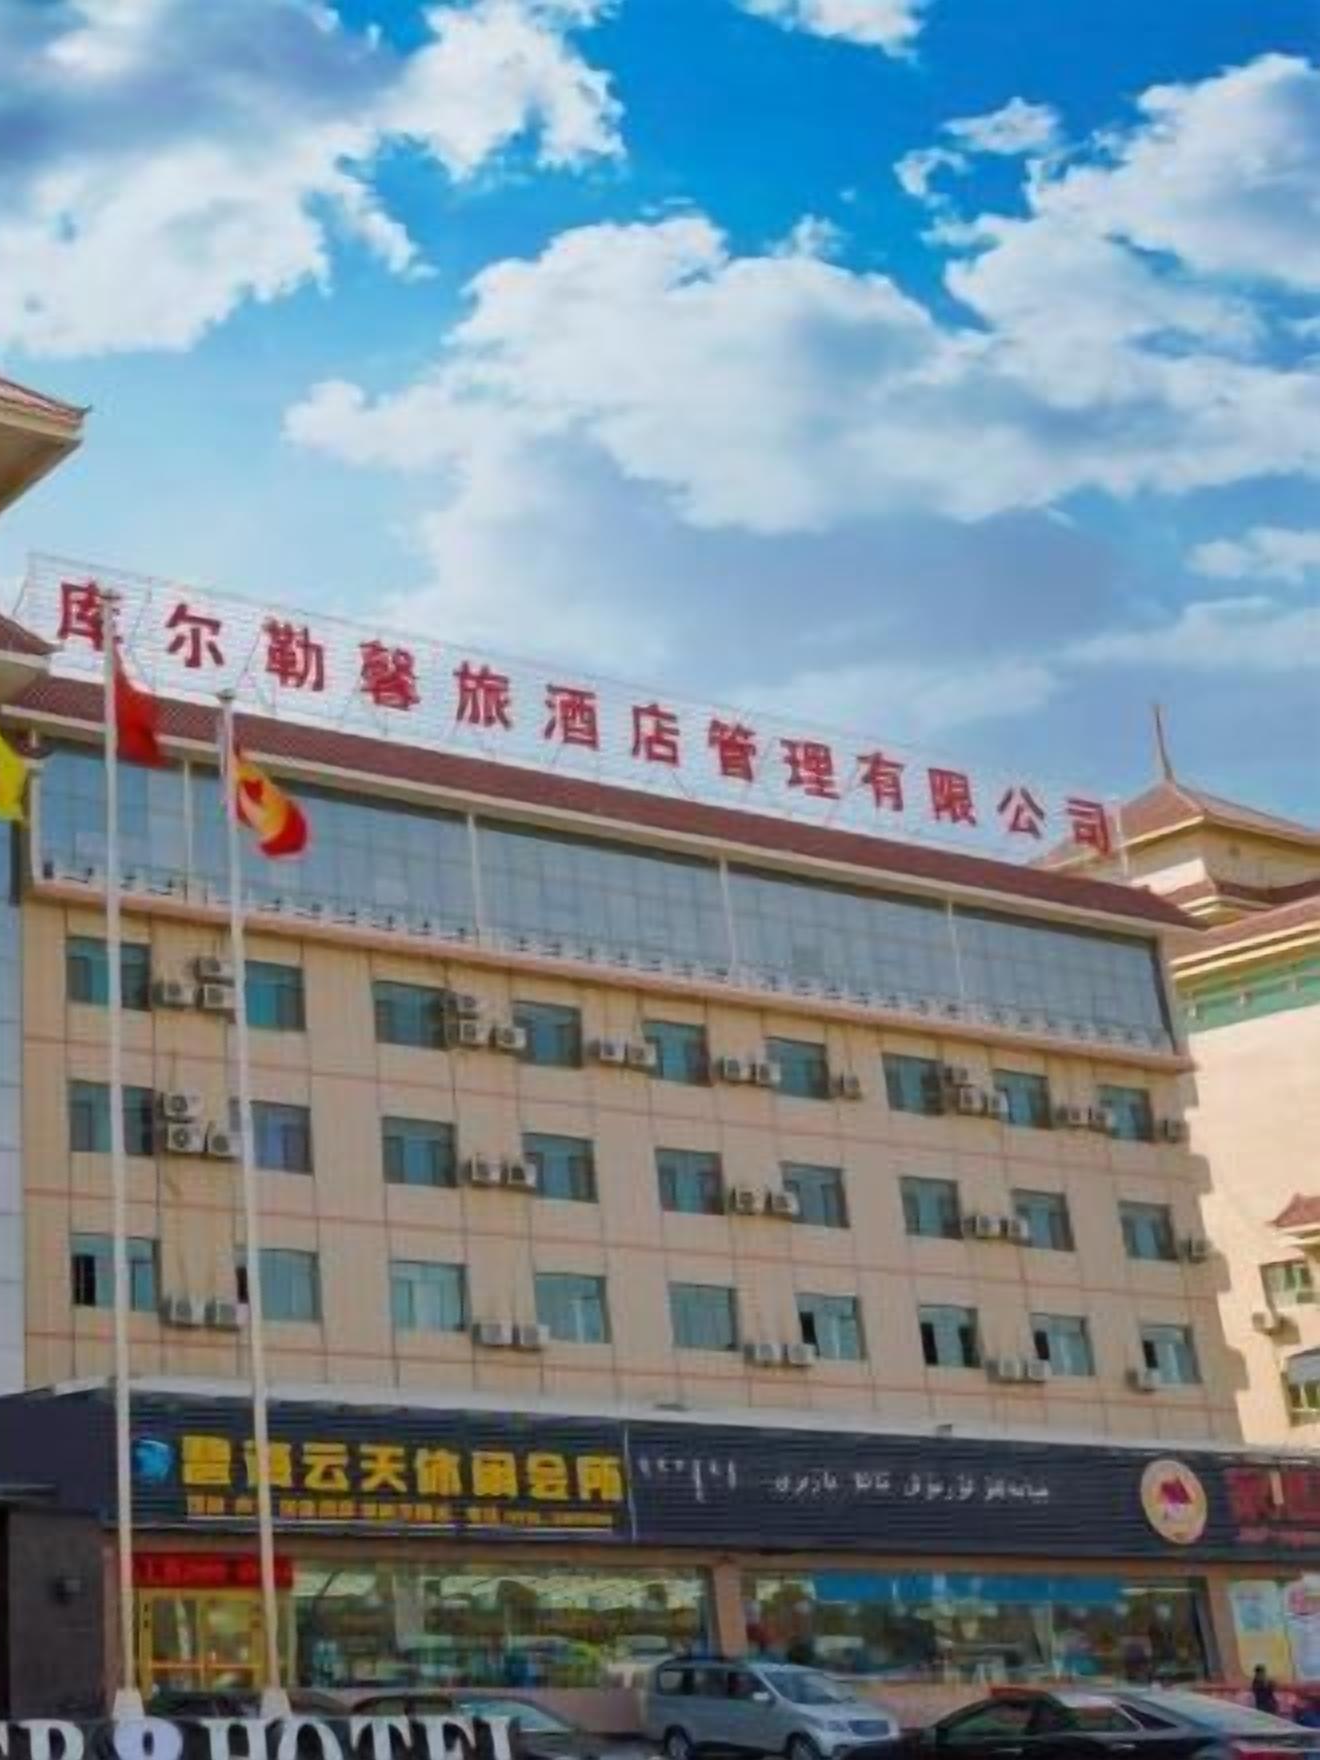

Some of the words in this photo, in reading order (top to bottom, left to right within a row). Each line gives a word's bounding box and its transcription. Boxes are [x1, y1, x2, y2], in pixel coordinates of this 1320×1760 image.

[57, 580, 1113, 856] 库尔勒馨旅酒店管理有限公司
